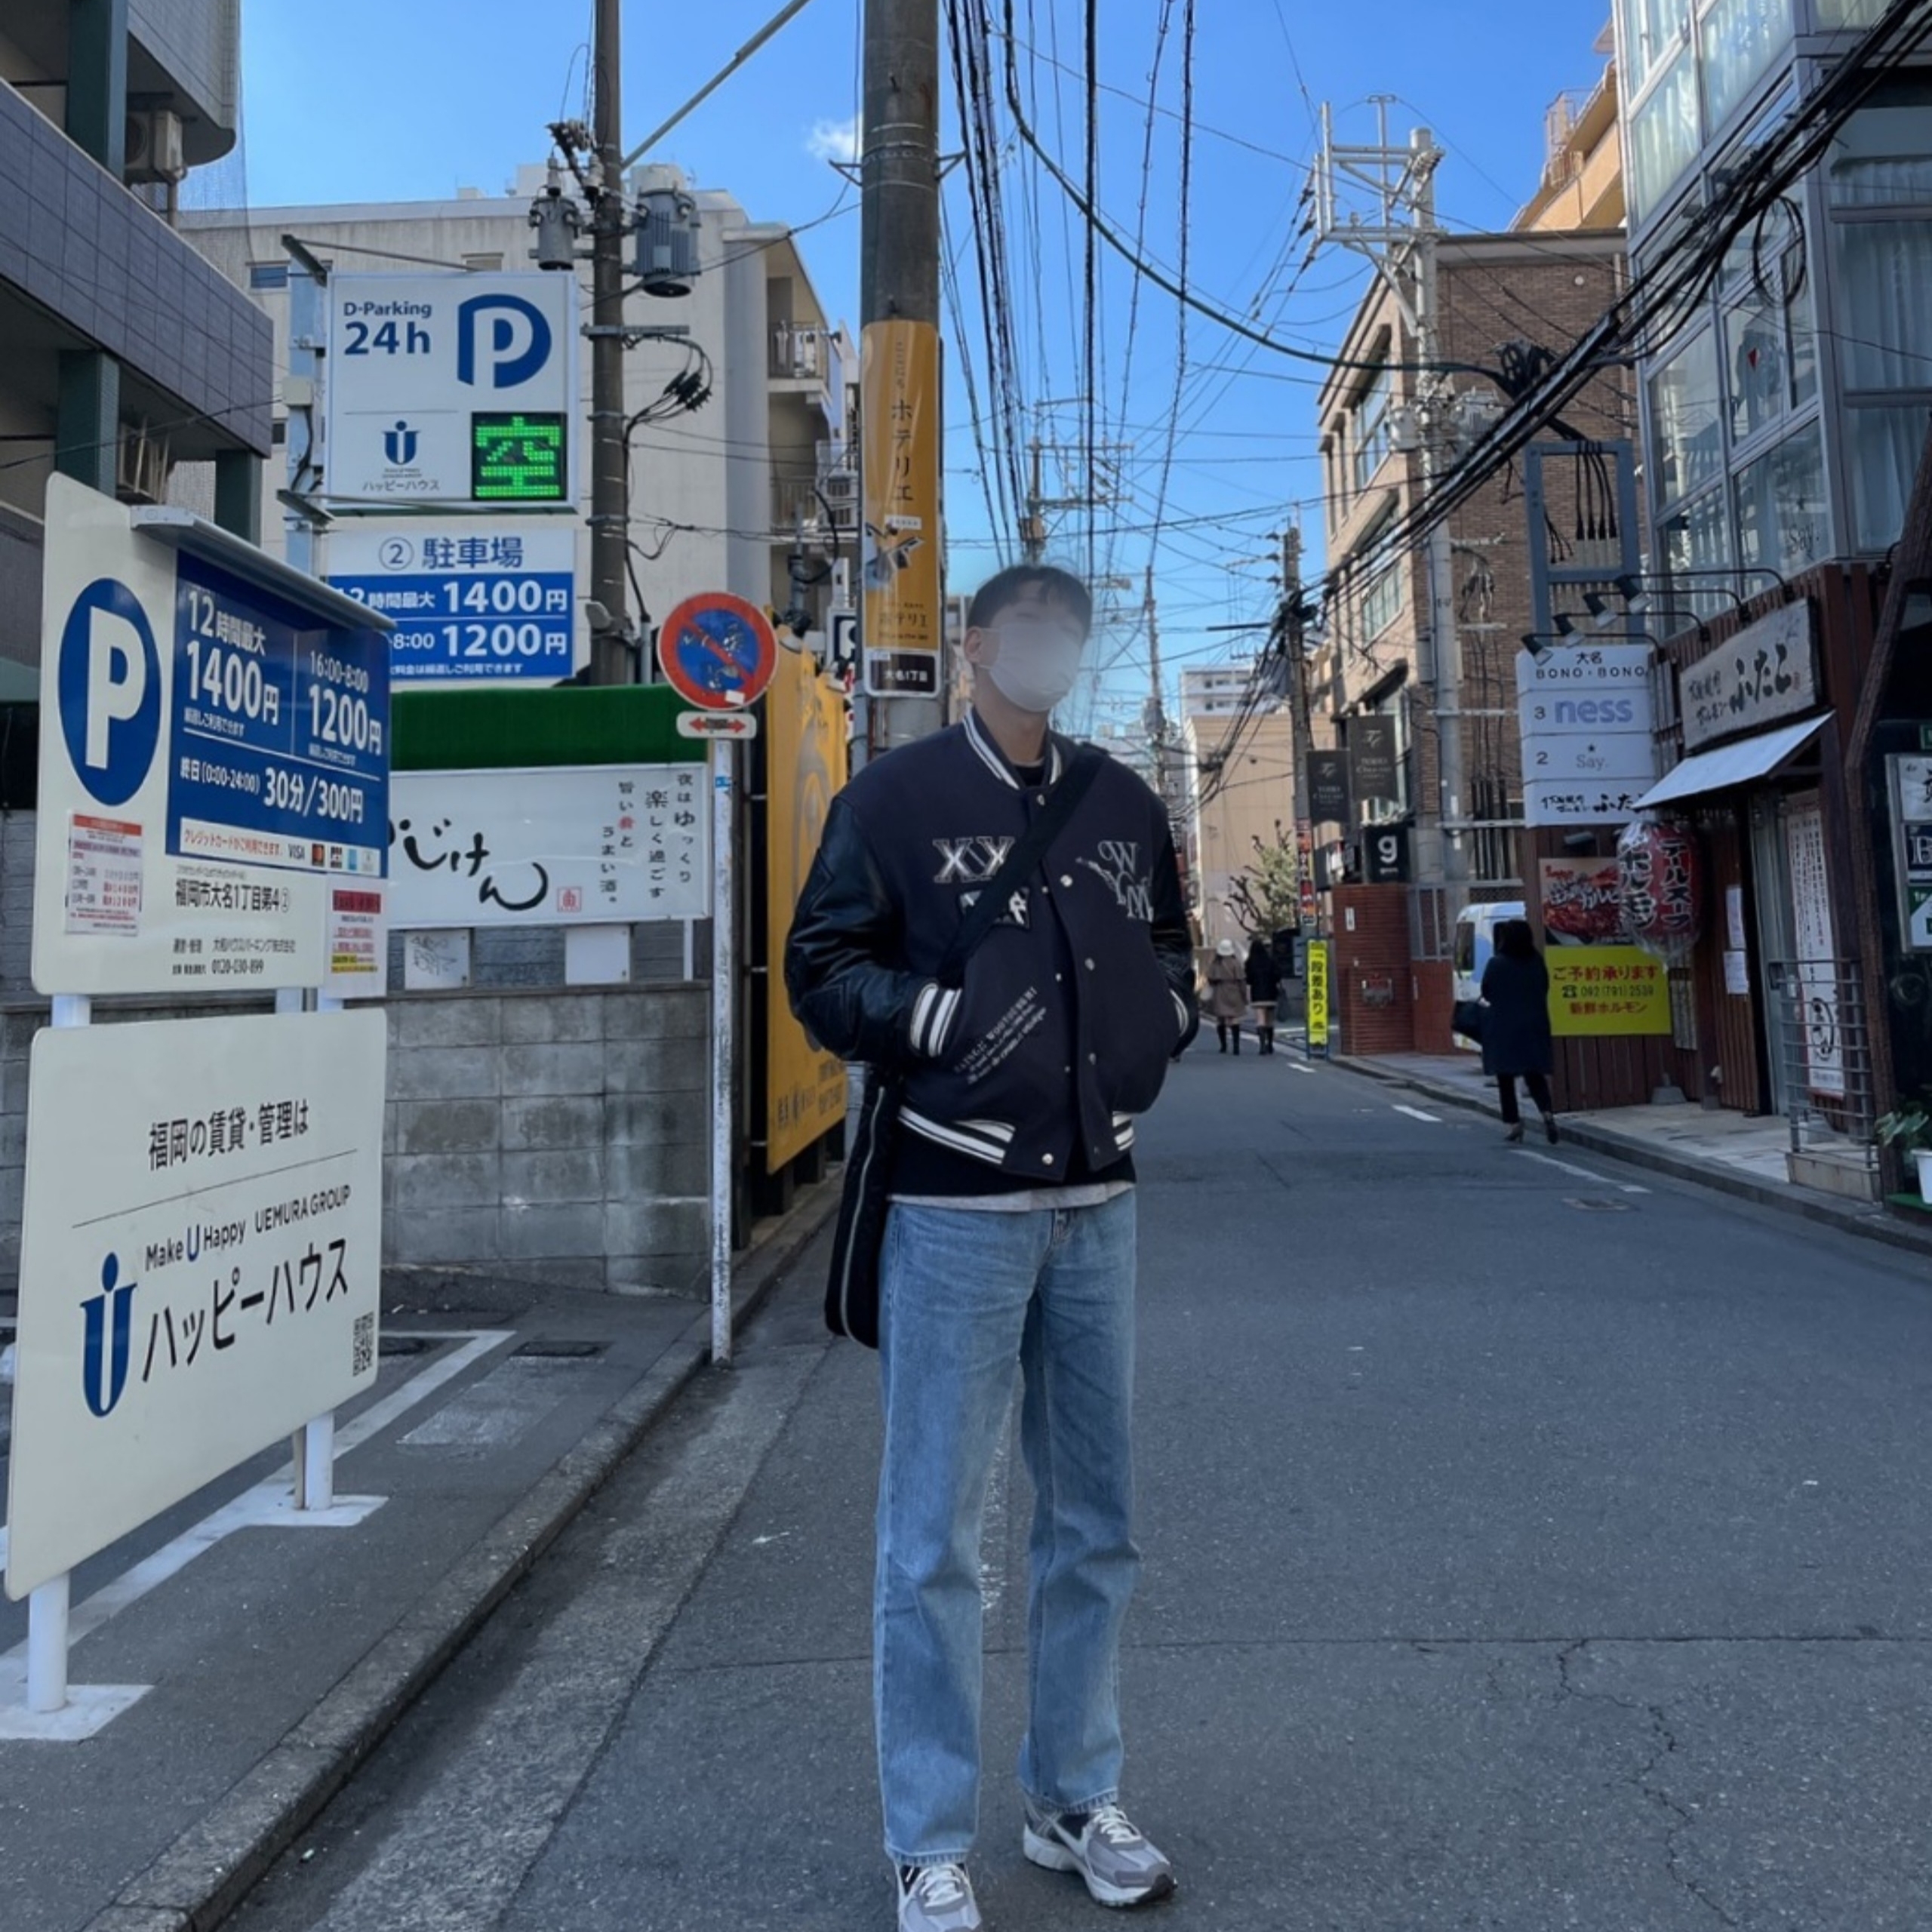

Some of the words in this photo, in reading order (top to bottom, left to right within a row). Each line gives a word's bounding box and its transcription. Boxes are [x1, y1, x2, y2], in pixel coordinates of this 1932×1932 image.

[343, 302, 432, 318] D-Parking
[344, 321, 430, 355] 24h
[475, 417, 561, 497] 空
[891, 399, 913, 500] ホテリエ
[363, 479, 439, 491] ハッピーハウス
[423, 537, 524, 568] 駐車場
[443, 580, 568, 613] 1400円
[442, 623, 568, 657] 1200円
[1576, 651, 1602, 665] 大名
[85, 605, 146, 771] P
[186, 640, 280, 726] 1400円
[308, 684, 382, 755] 1200円
[1534, 706, 1546, 721] 3
[1554, 699, 1633, 724] ness
[1536, 752, 1549, 765] 2
[1377, 835, 1398, 864] g
[1553, 964, 1658, 980] ご予約承ります
[149, 1099, 309, 1171] 福岡の賃貸・管理は
[146, 1238, 184, 1272] Make
[186, 1223, 201, 1263] U
[203, 1220, 247, 1254] Happy
[254, 1198, 308, 1234] UEMURA
[309, 1183, 352, 1218] GROUP
[142, 1238, 349, 1383] ハッピーハウス
